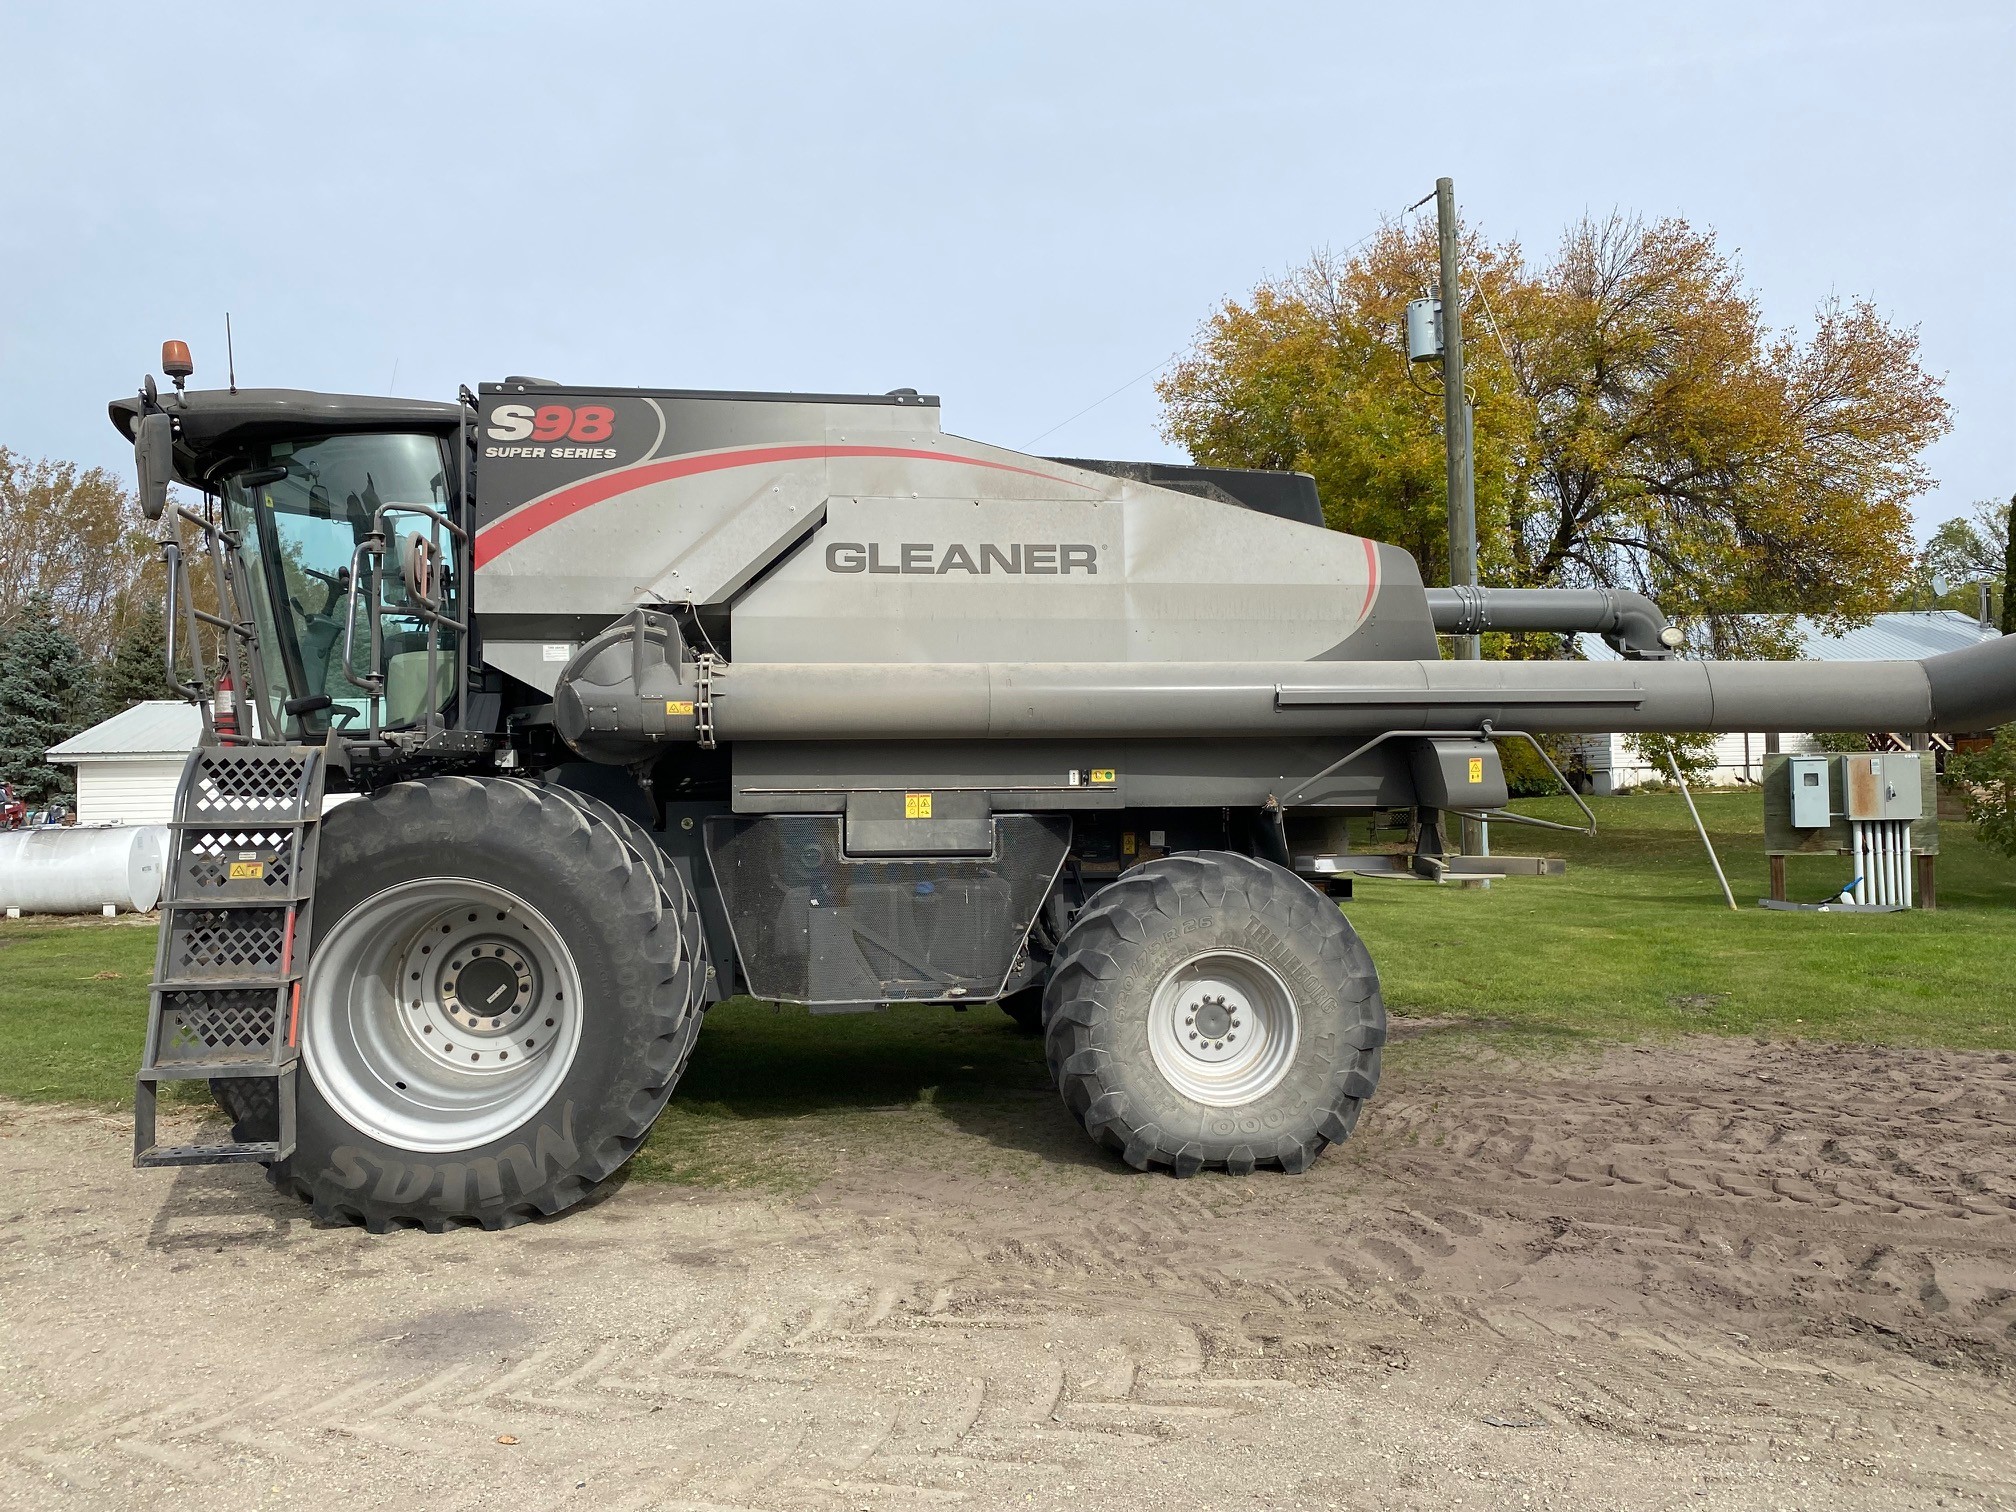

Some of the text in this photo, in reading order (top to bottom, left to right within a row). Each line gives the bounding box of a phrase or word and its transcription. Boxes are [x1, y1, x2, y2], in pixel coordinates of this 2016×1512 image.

[487, 404, 615, 442] S98
[485, 446, 617, 459] SUPER SERIES
[825, 542, 1098, 574] GLEANER
[1245, 914, 1339, 1015] TRELLEBORG
[322, 1099, 580, 1210] Mitas
